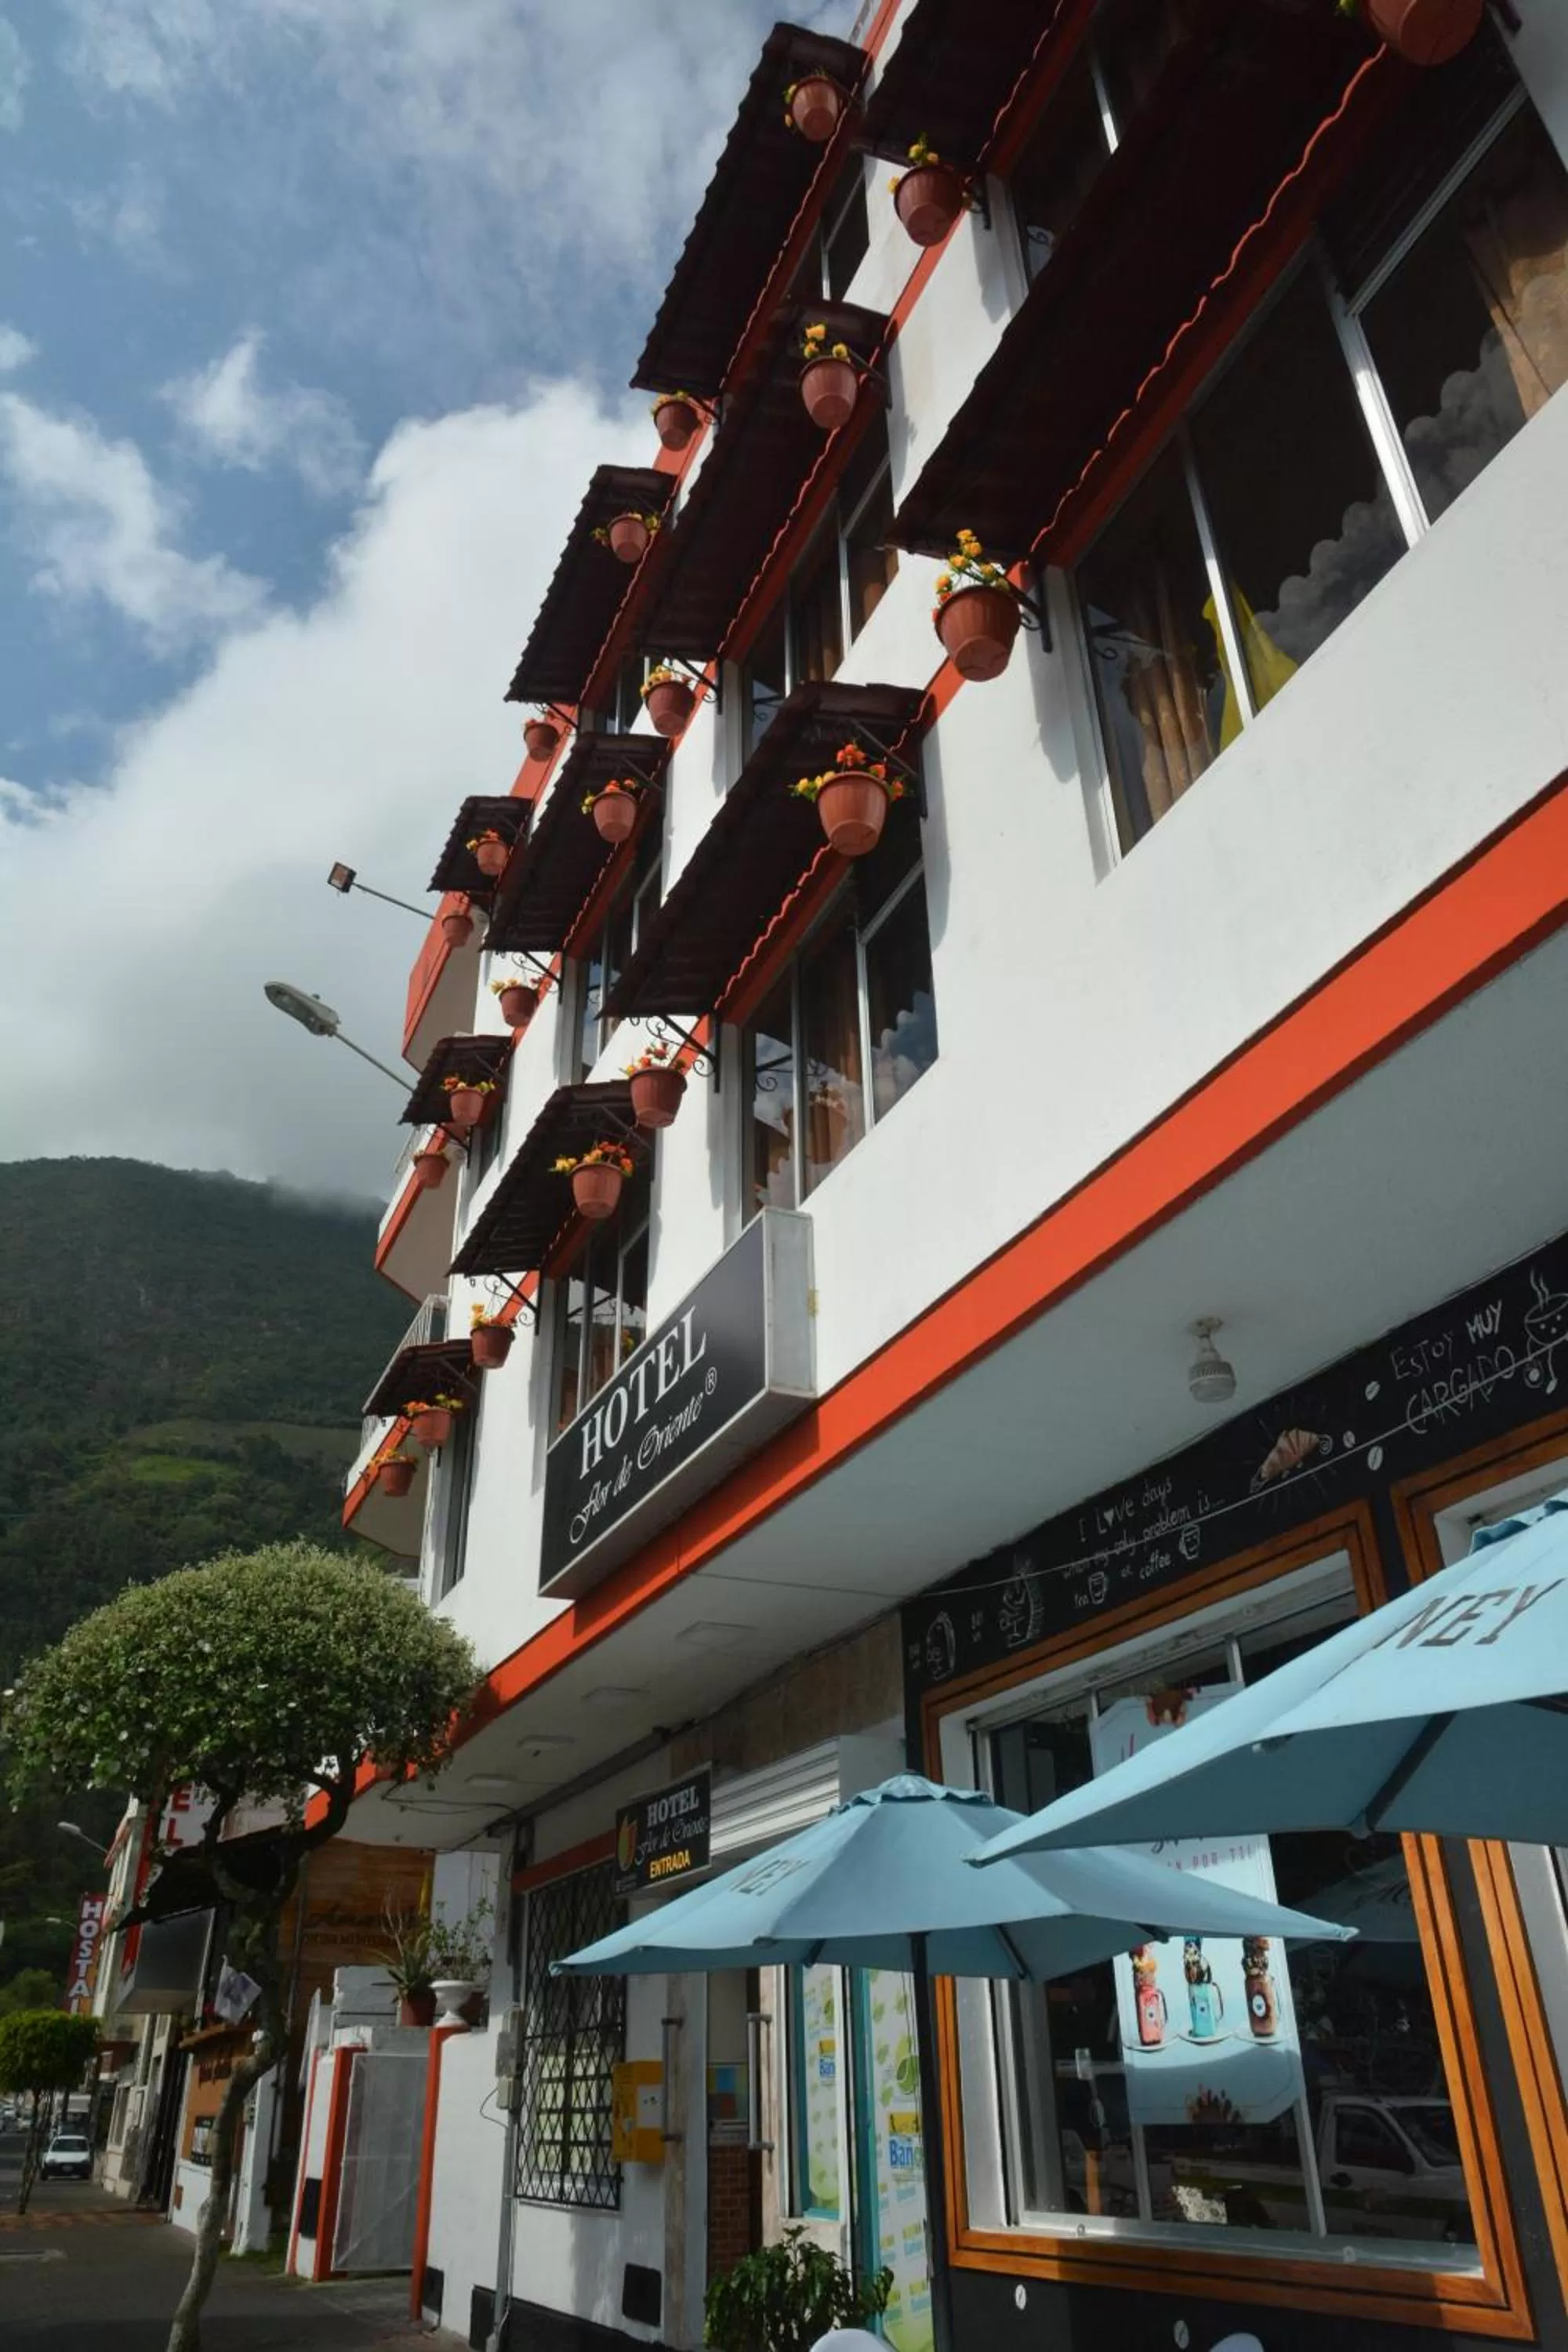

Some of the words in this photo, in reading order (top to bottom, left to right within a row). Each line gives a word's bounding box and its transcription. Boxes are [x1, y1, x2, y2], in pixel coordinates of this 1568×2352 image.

[1390, 1330, 1454, 1381] ESTOY
[1465, 1298, 1502, 1345] MUY
[579, 1305, 707, 1481] HOTEL
[1406, 1346, 1515, 1434] CARGADO
[569, 1479, 612, 1544] Flor
[612, 1454, 633, 1497] de
[647, 1785, 699, 1828] HOTEL
[649, 1848, 691, 1880] ENTRADA
